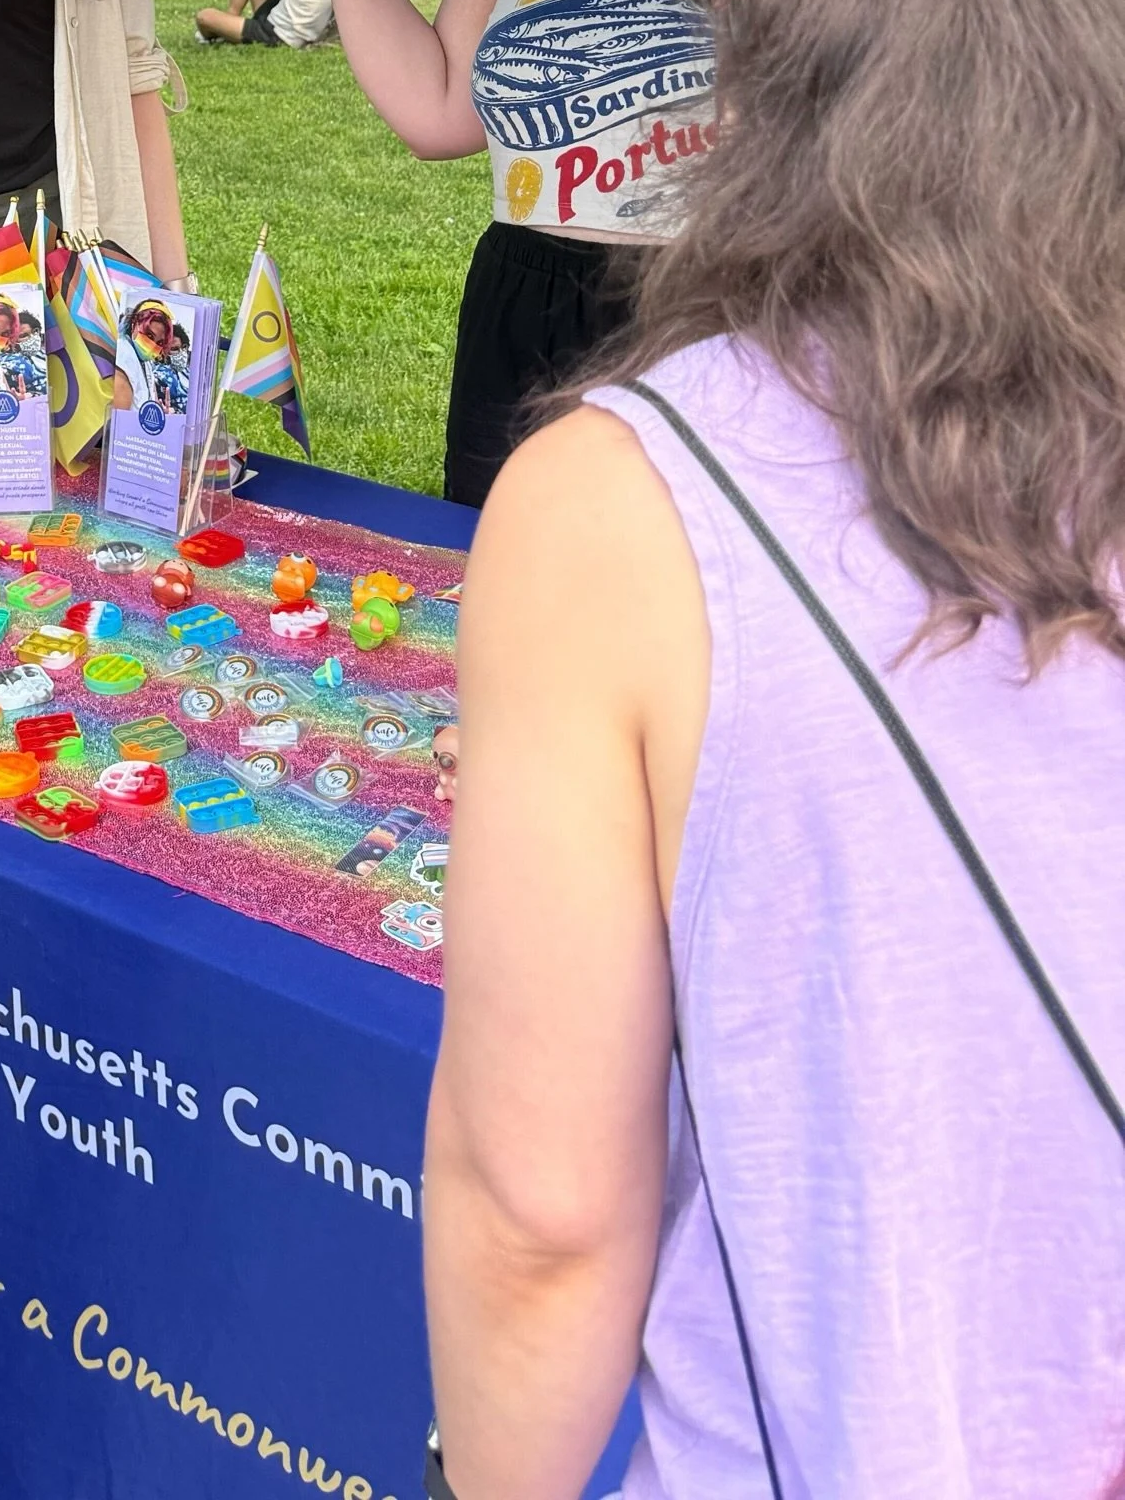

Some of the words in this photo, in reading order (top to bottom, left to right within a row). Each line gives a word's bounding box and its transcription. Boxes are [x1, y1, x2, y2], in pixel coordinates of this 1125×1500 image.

[376, 727, 395, 738] safe
[0, 1063, 154, 1185] Youth
[222, 1086, 424, 1220] Comm
[21, 1298, 53, 1340] a
[73, 1304, 399, 1500] Commonwe
